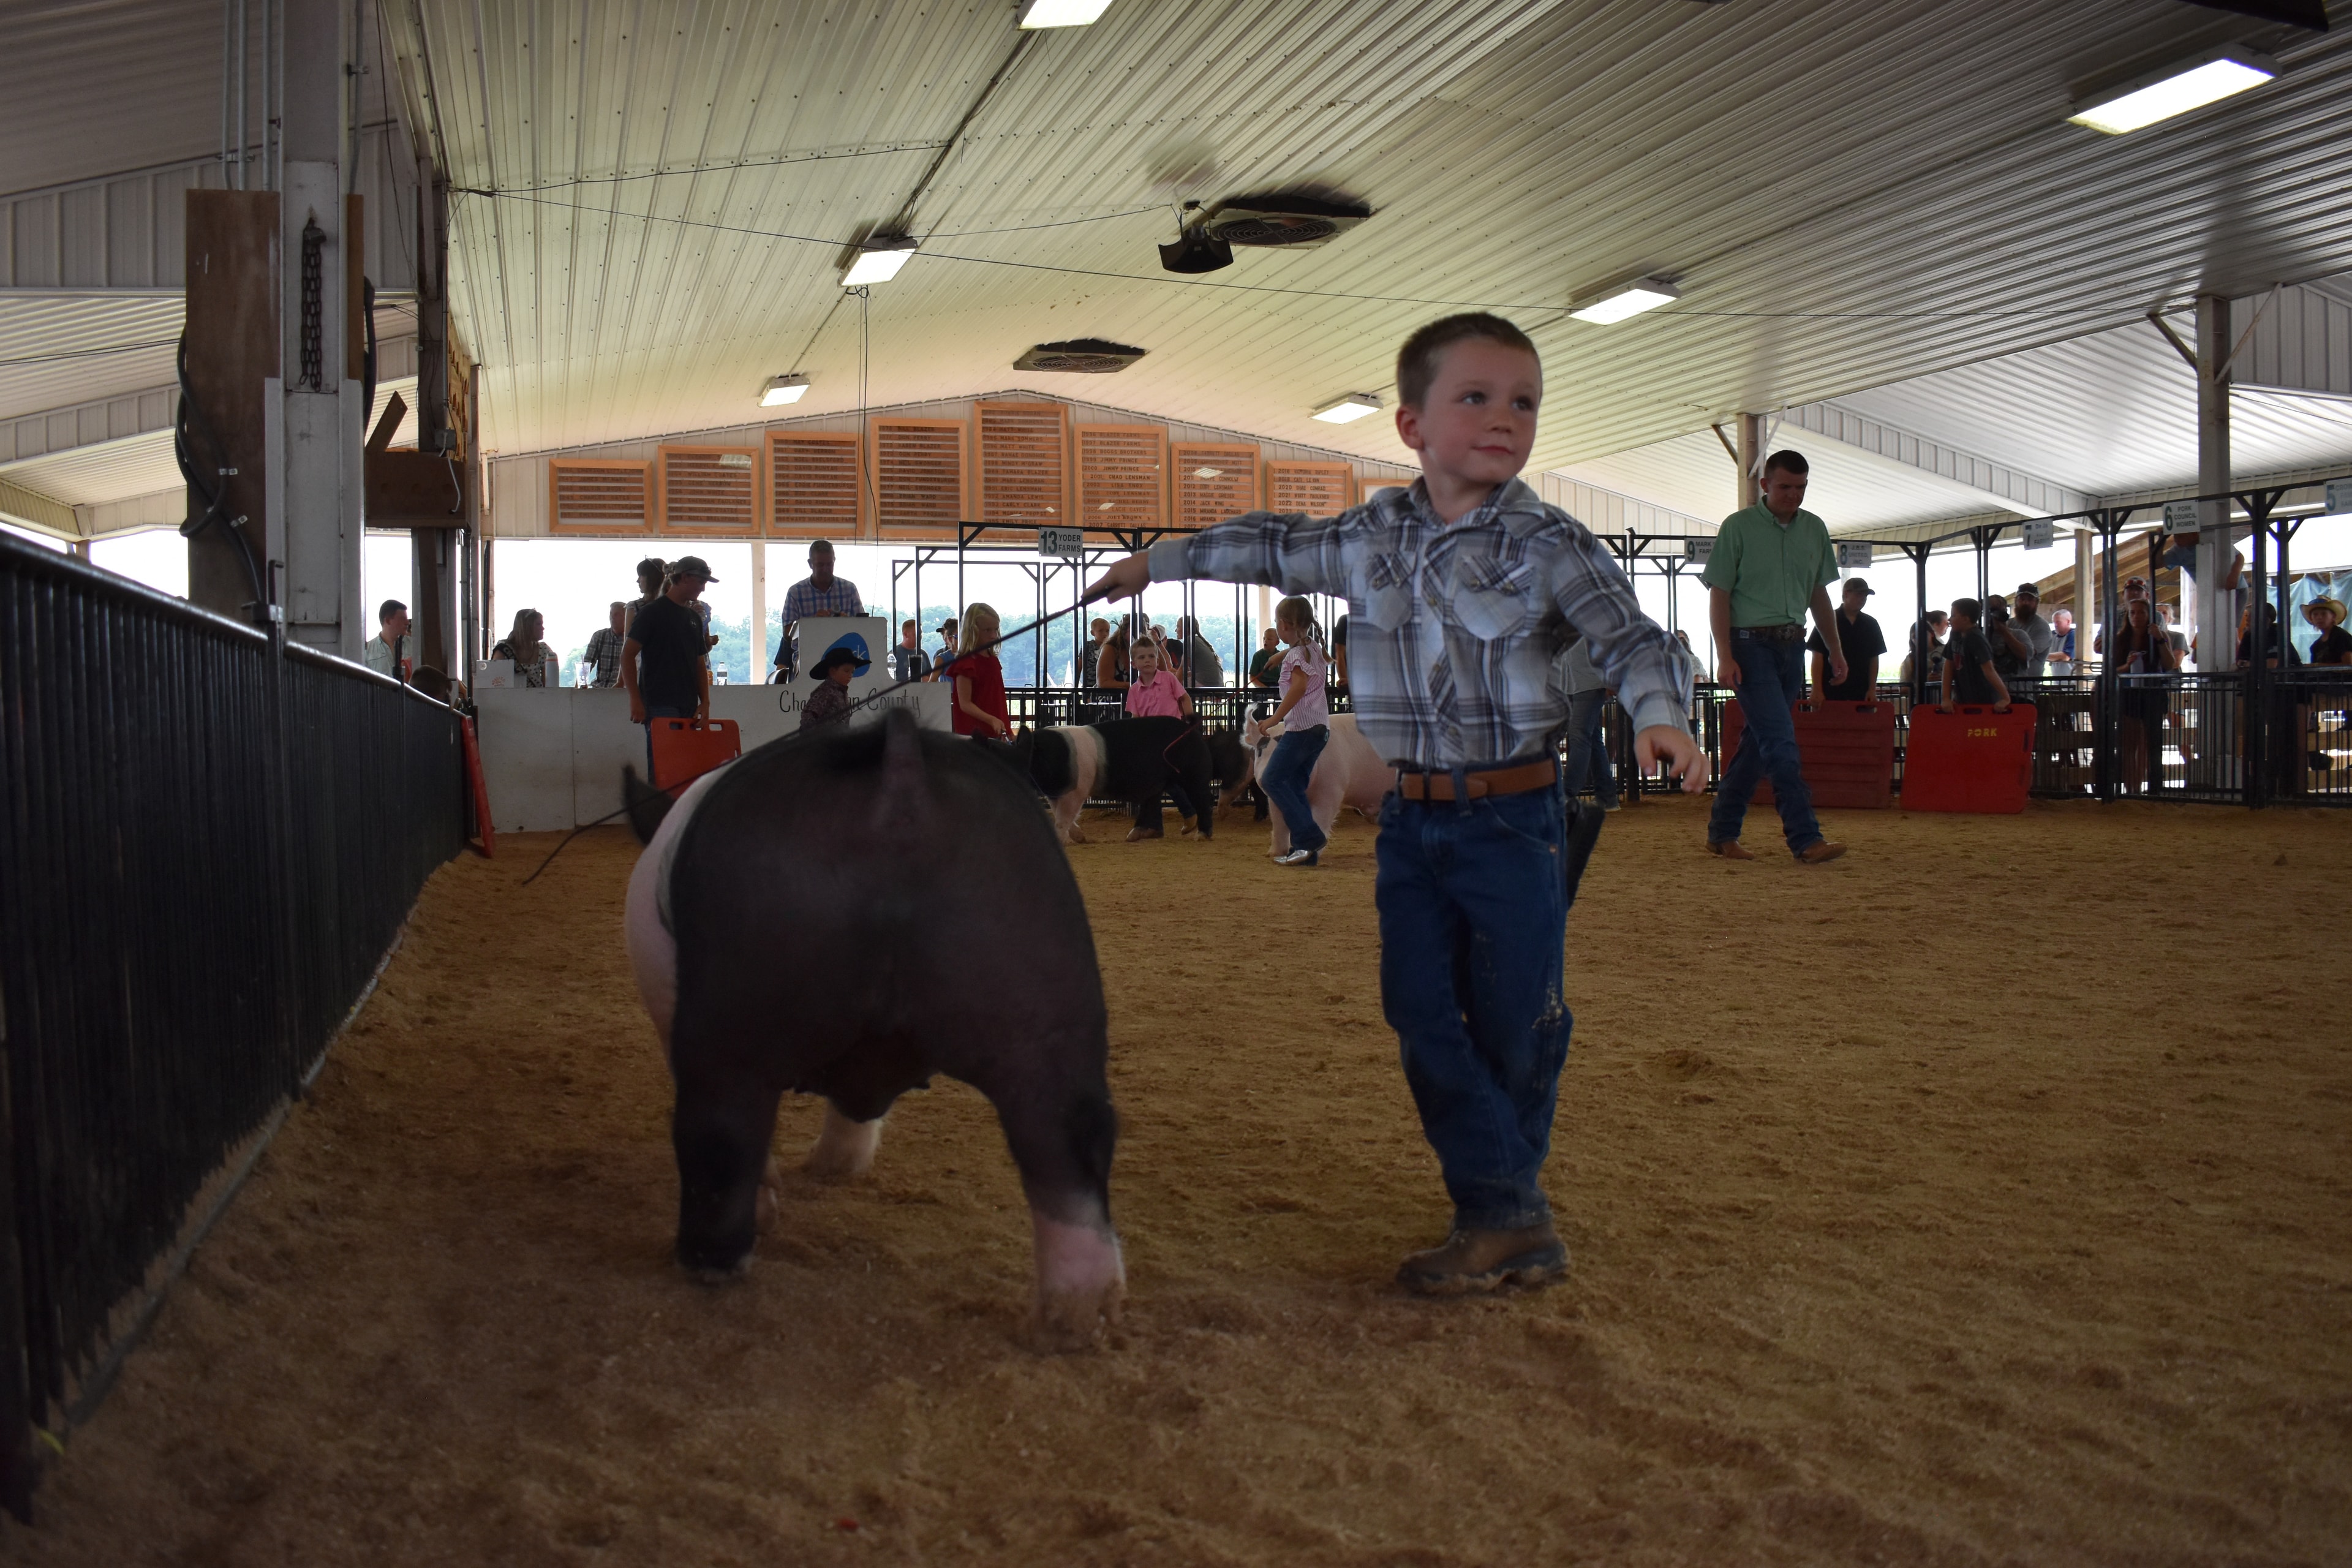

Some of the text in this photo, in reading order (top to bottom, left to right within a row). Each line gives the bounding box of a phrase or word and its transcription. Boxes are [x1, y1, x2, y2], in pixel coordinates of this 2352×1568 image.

[2326, 484, 2335, 511] 5
[2165, 505, 2173, 531] 6
[1041, 530, 1058, 554] 13
[1058, 544, 1080, 552] FARMS
[1687, 540, 1695, 562] 9
[1839, 544, 1848, 565] 8
[1967, 728, 1997, 737] PORK
